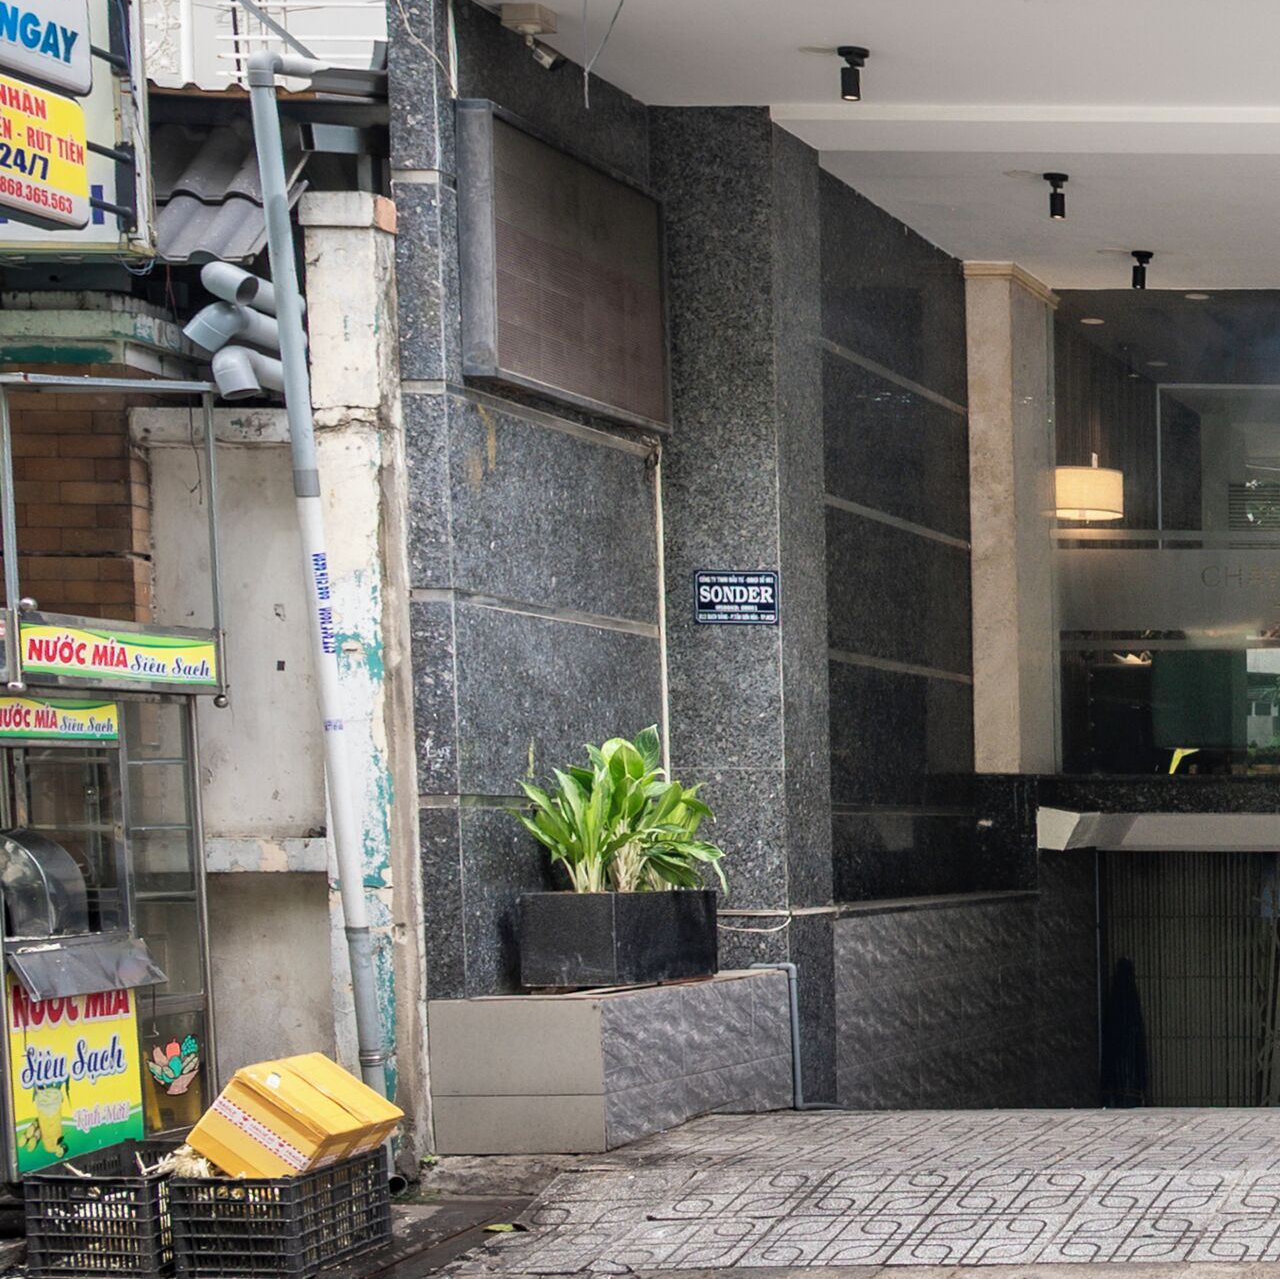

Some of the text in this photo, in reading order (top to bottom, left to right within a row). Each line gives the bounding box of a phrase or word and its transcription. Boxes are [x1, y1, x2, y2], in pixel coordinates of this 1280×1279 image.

[0, 1, 78, 64] NGAY
[0, 142, 49, 181] 24/7
[26, 124, 52, 154] RÚT
[57, 132, 85, 166] TIỀN
[699, 585, 774, 603] SONDER
[28, 634, 210, 680] NƯỚC MÍA Siêu Sạch
[34, 704, 58, 729] MÍA
[59, 714, 84, 732] Siêu
[87, 716, 114, 737] Sạch
[22, 1035, 125, 1085] Siêu Sạch
